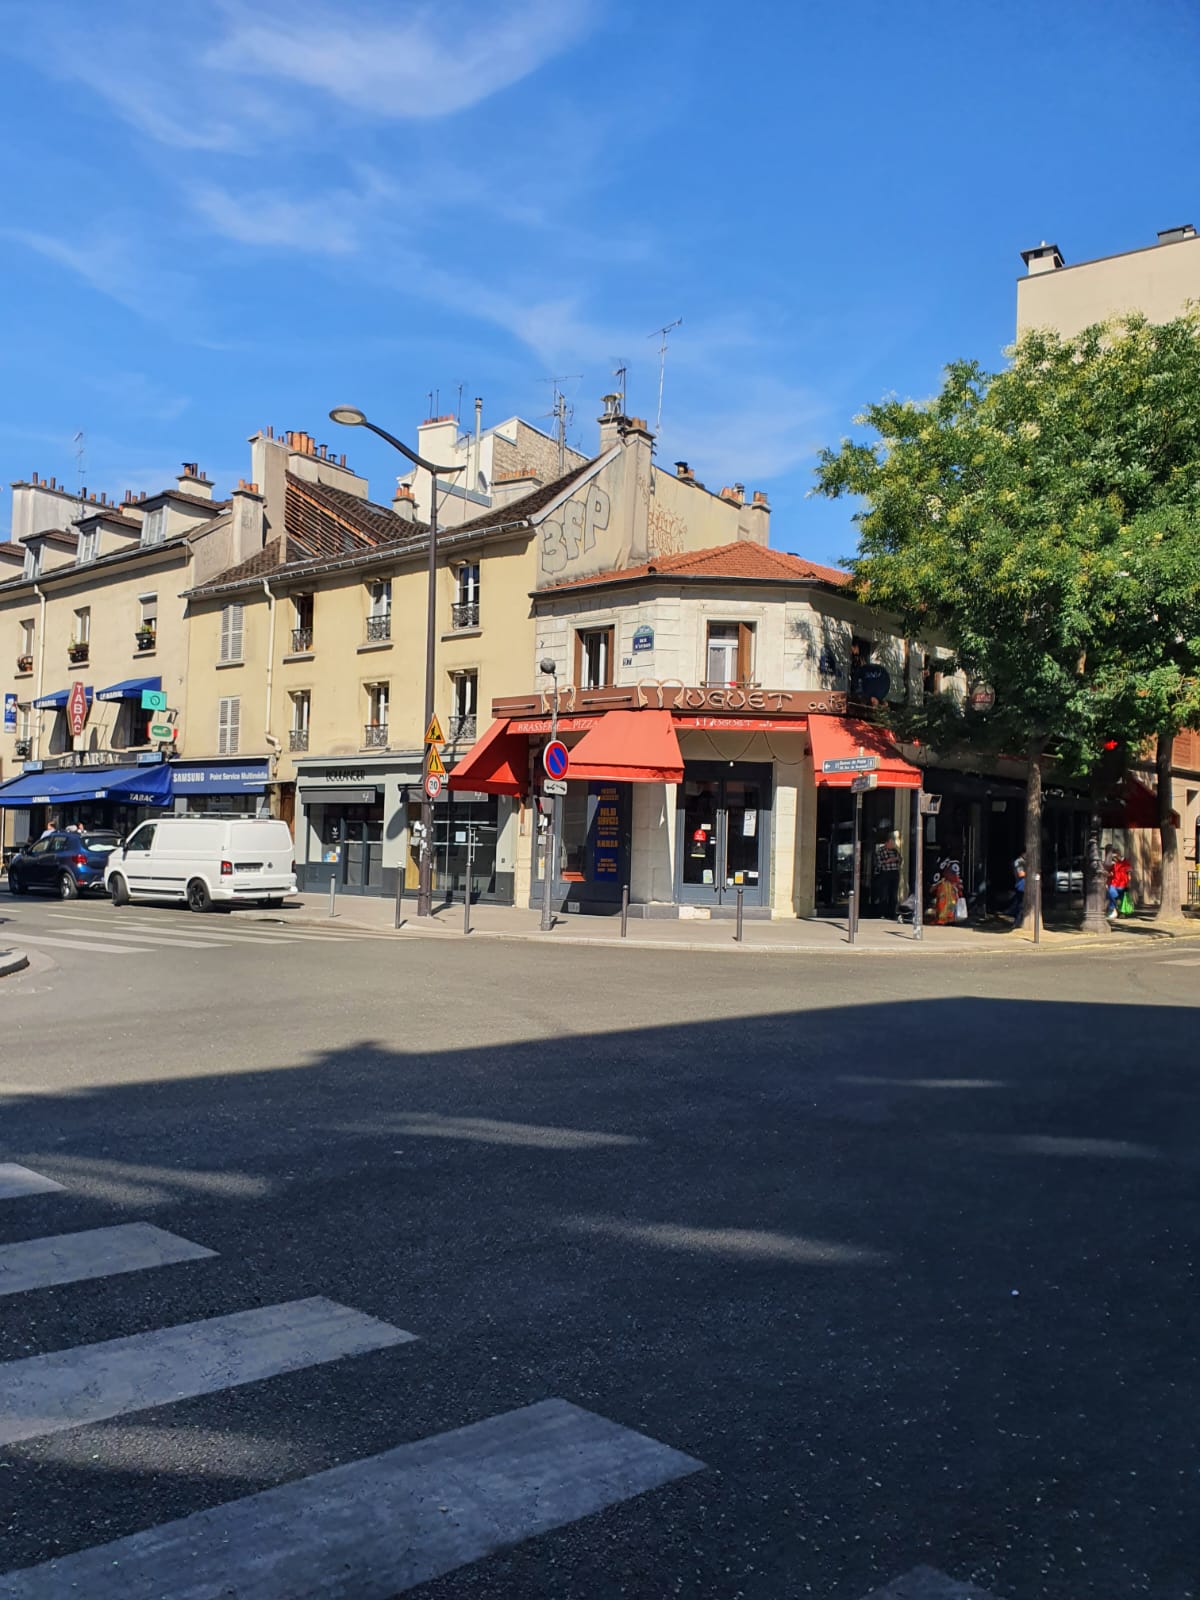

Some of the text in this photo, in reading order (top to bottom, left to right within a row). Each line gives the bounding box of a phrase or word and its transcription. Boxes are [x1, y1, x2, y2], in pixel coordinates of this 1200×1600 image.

[73, 685, 83, 733] TABAC
[518, 721, 560, 732] BRASSERE
[173, 772, 205, 783] SAMSUNG
[223, 772, 240, 780] Service
[429, 780, 438, 790] 30
[130, 793, 154, 802] TABAC
